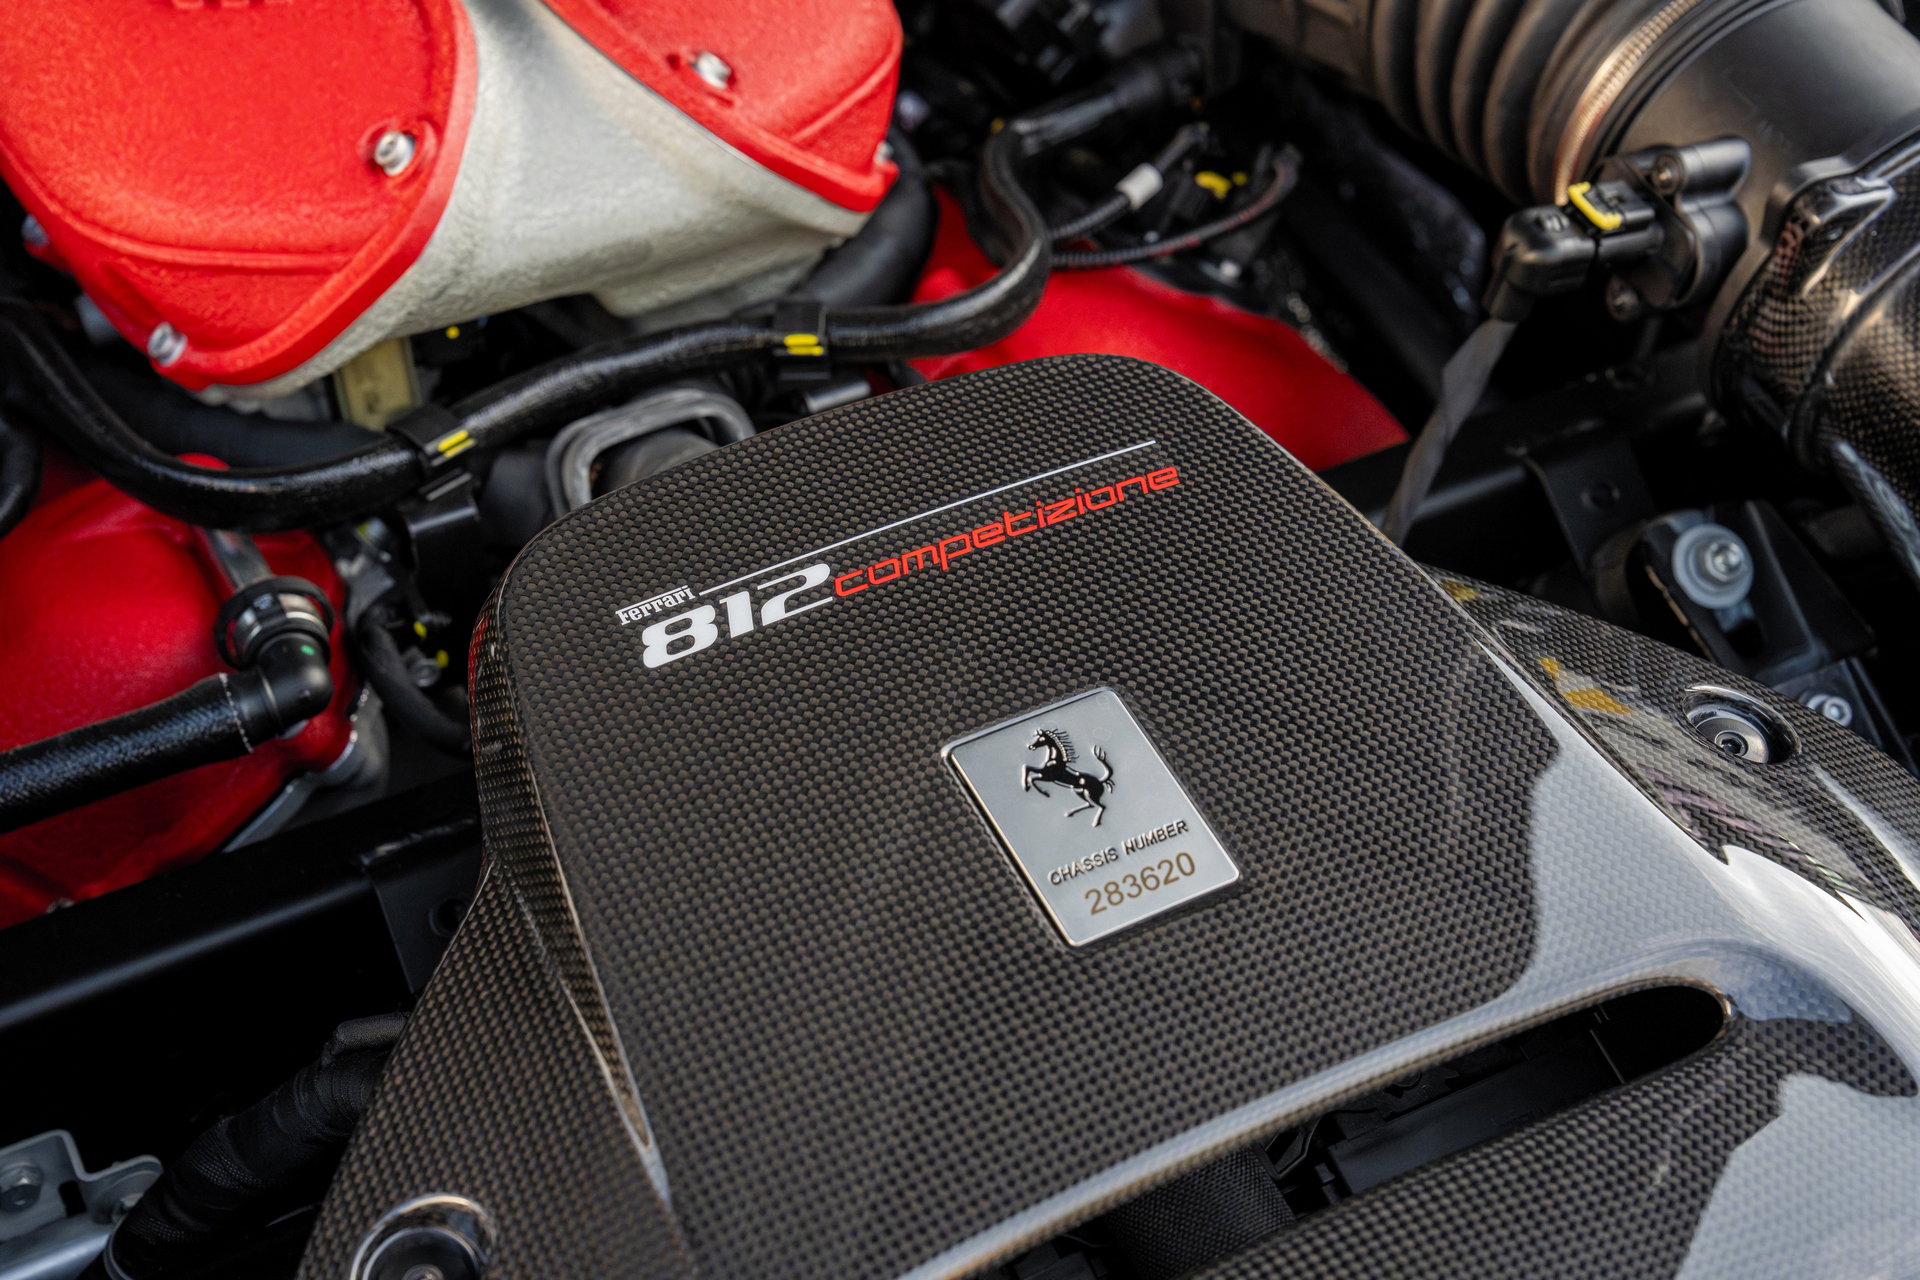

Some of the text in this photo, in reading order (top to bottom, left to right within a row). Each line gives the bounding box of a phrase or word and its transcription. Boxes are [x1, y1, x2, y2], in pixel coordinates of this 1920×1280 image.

[641, 466, 1181, 669] 812 competizione
[615, 585, 696, 626] Ferrari
[1048, 818, 1189, 886] CHASSIS NUMBER
[1084, 852, 1196, 916] 283620
